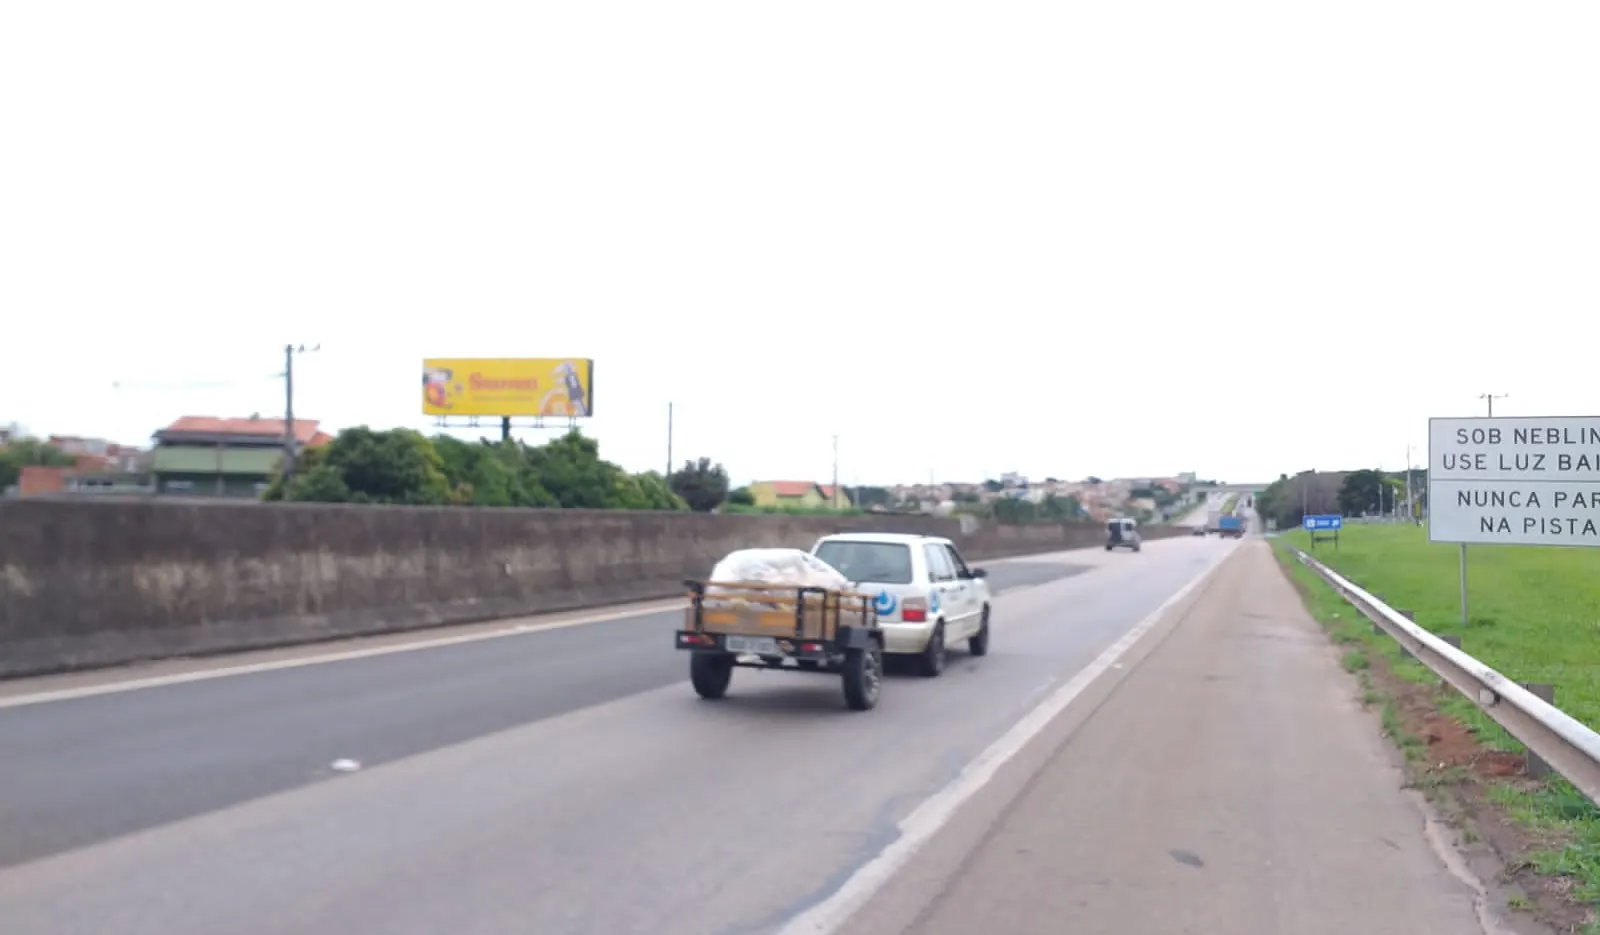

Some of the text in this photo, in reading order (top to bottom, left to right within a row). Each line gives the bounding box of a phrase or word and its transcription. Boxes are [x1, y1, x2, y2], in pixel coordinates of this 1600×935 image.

[1456, 427, 1600, 445] SOB NEBLIN
[1443, 453, 1600, 471] USE LUZ BAI
[1457, 490, 1600, 509] NUNCA PAR
[1480, 516, 1597, 536] NA PISTA
